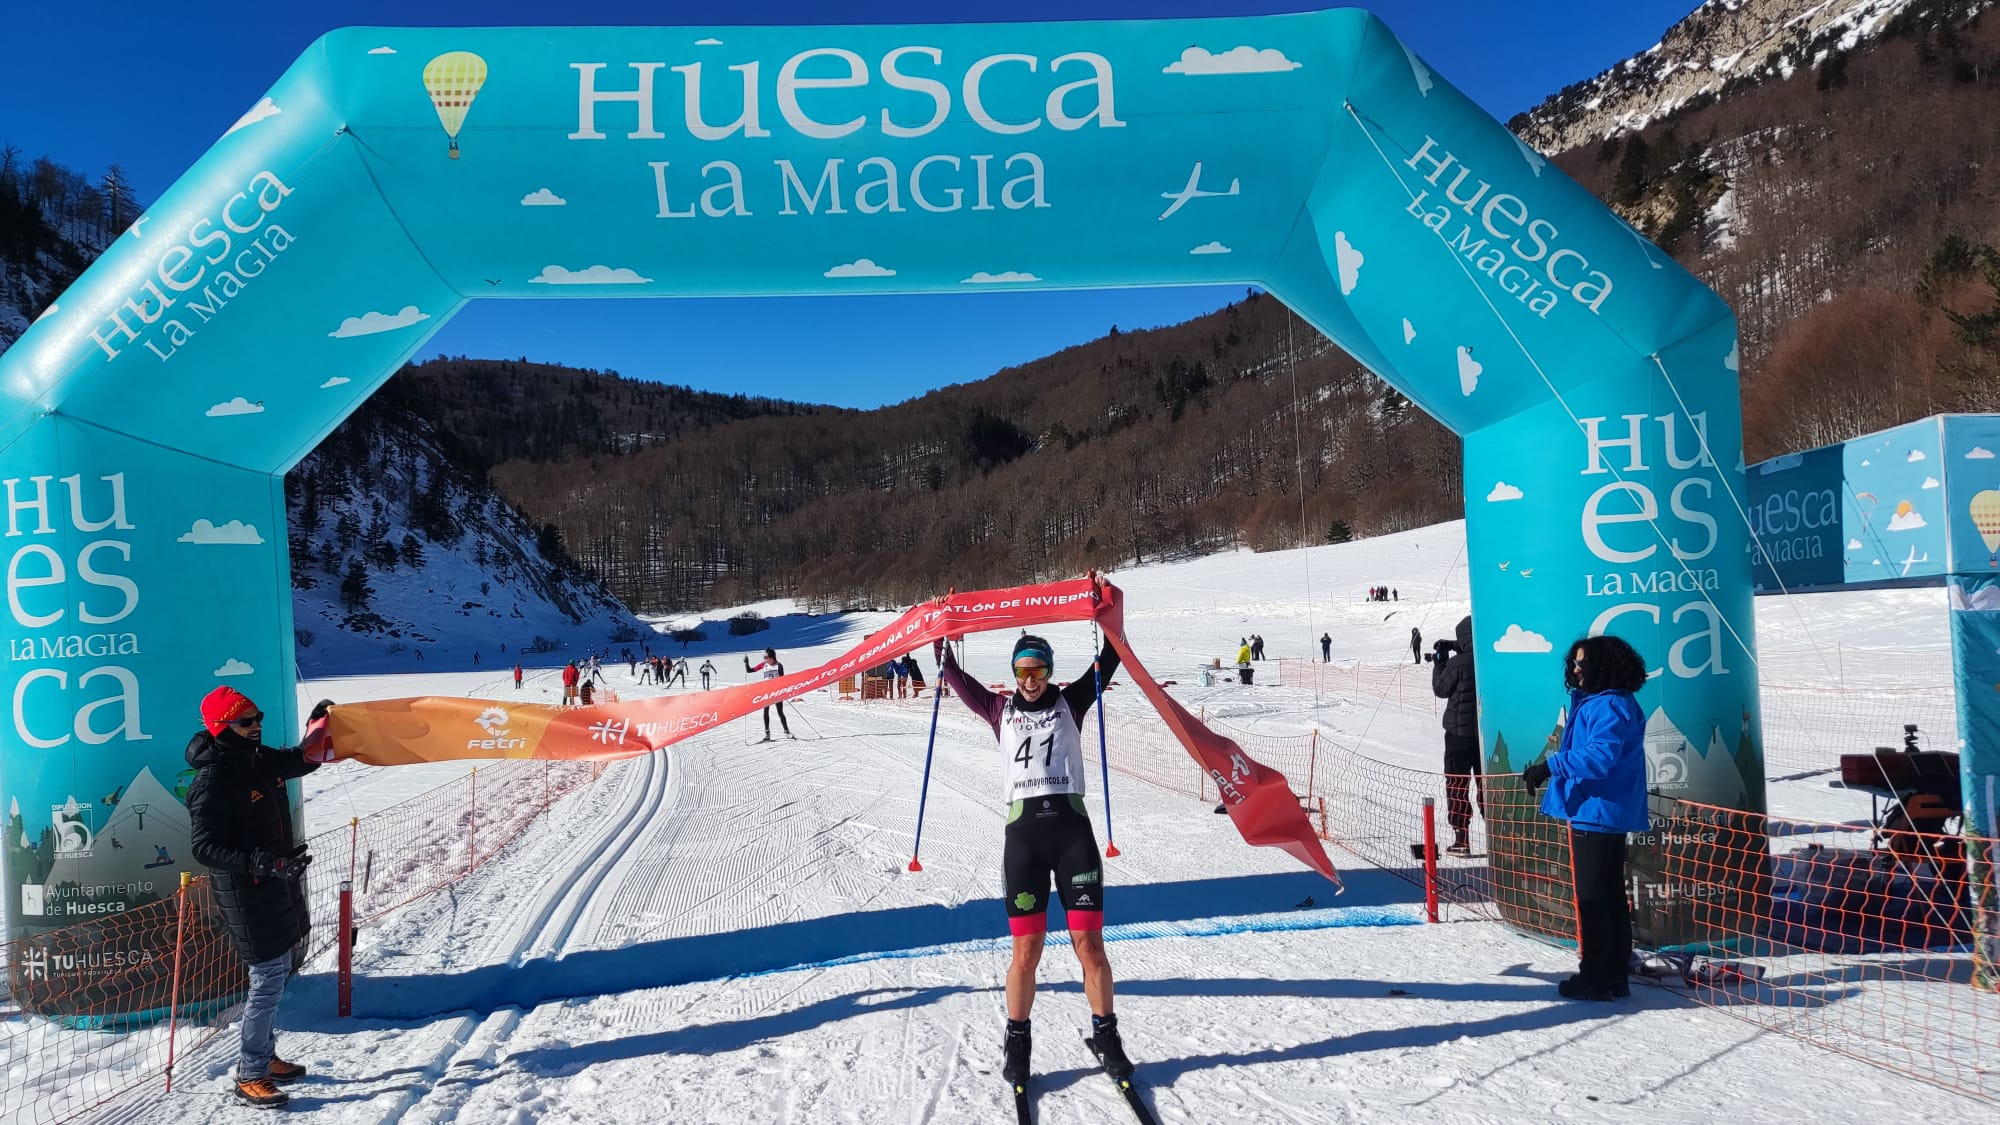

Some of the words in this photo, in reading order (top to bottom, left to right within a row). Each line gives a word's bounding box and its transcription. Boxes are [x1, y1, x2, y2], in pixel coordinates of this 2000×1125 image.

[567, 46, 1126, 141] Huesca
[1404, 134, 1613, 315] Huesca
[86, 170, 295, 362] Huesca
[1748, 489, 1838, 538] uesca
[752, 668, 837, 704] CAMPEONATO
[839, 658, 857, 672] DE
[858, 631, 903, 663] ESPAÑA
[906, 617, 921, 636] DE
[1000, 599, 1020, 609] DE
[1025, 590, 1100, 606] INVIERNO
[635, 711, 719, 737] TUHUESCA
[1014, 732, 1055, 769] 41
[1014, 776, 1069, 789] www.mayencos.es
[1637, 832, 1656, 845] de
[1661, 831, 1716, 845] Huesca
[45, 879, 153, 901] Ayuntamiento
[46, 902, 62, 916] de
[66, 901, 125, 915] Huesca
[52, 950, 153, 970] TUHUESCA
